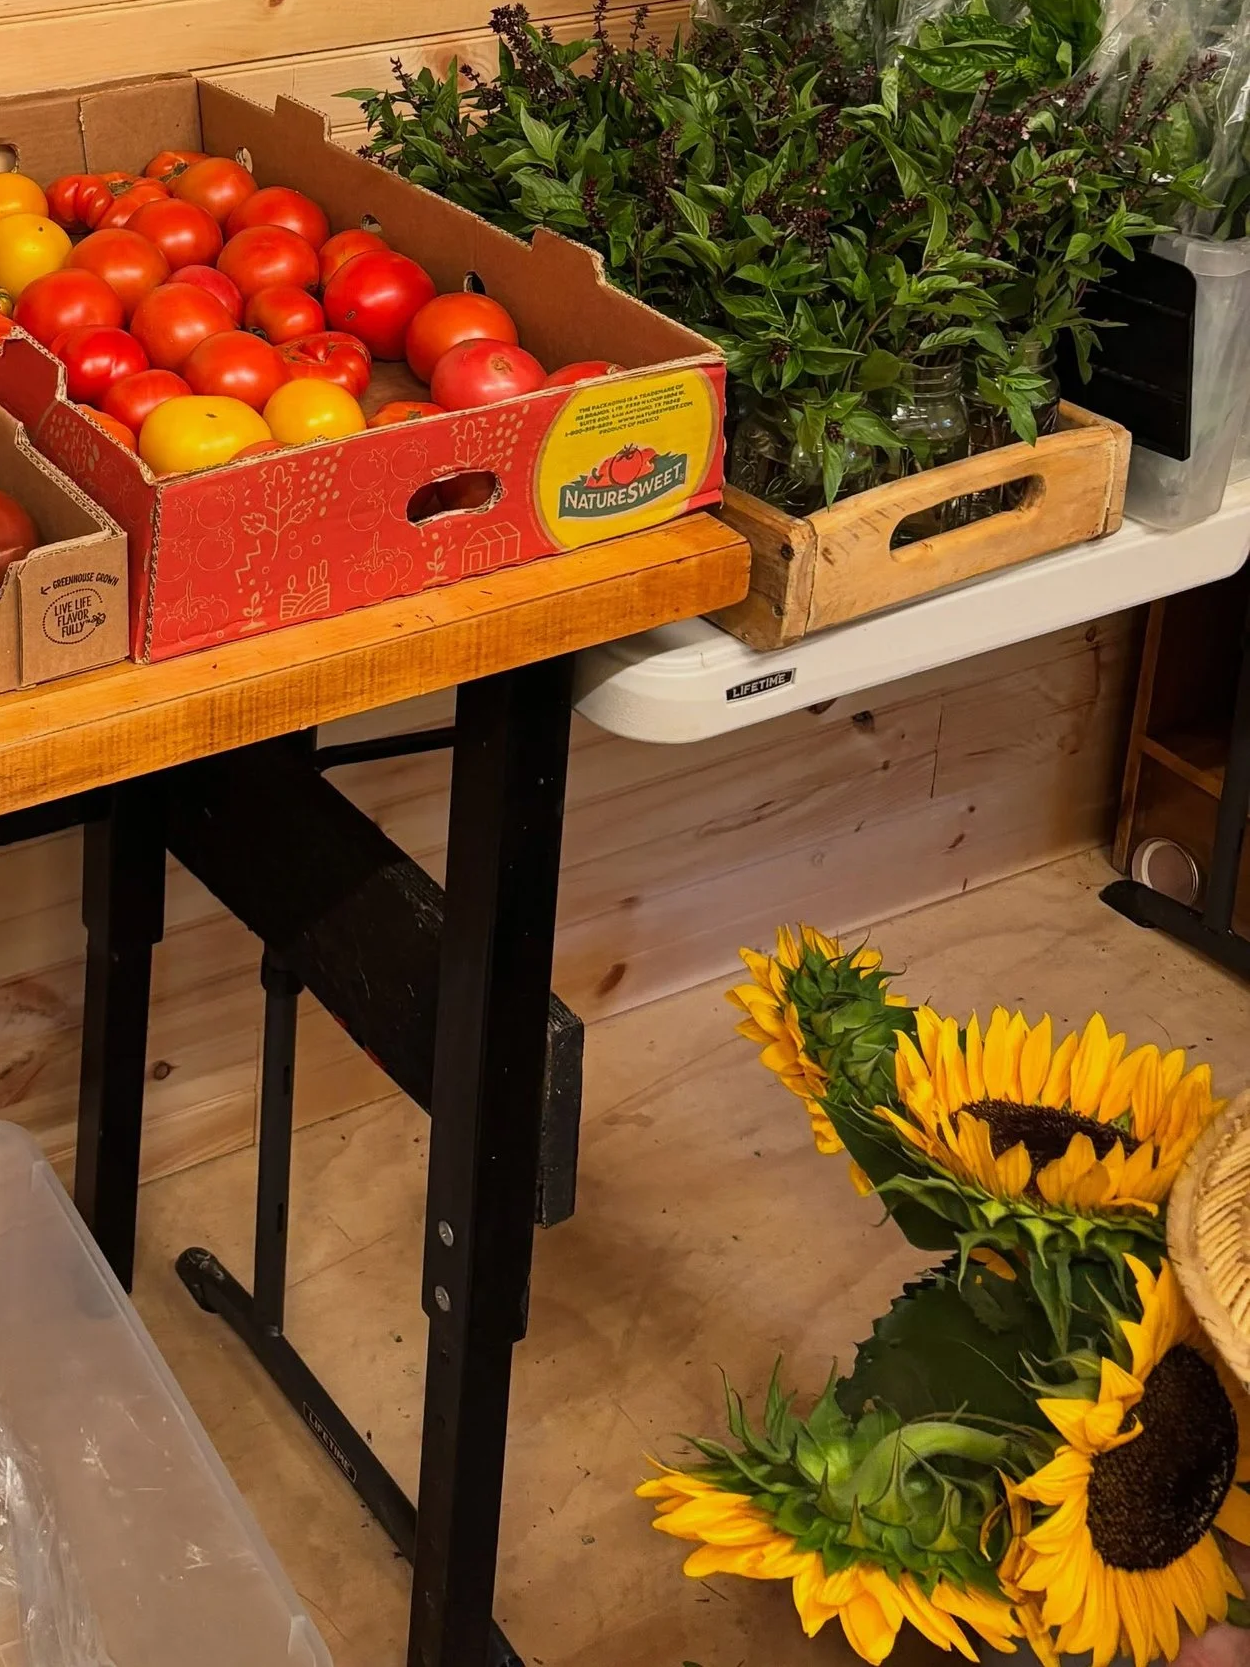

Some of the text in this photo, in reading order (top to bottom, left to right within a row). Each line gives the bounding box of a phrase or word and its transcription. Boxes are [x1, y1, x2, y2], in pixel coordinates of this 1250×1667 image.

[53, 572, 120, 589] GREENHOUSE GROWN
[54, 595, 92, 616] LIVE LIFE
[57, 609, 89, 627] FLAVOR
[732, 673, 787, 698] LIFETIME
